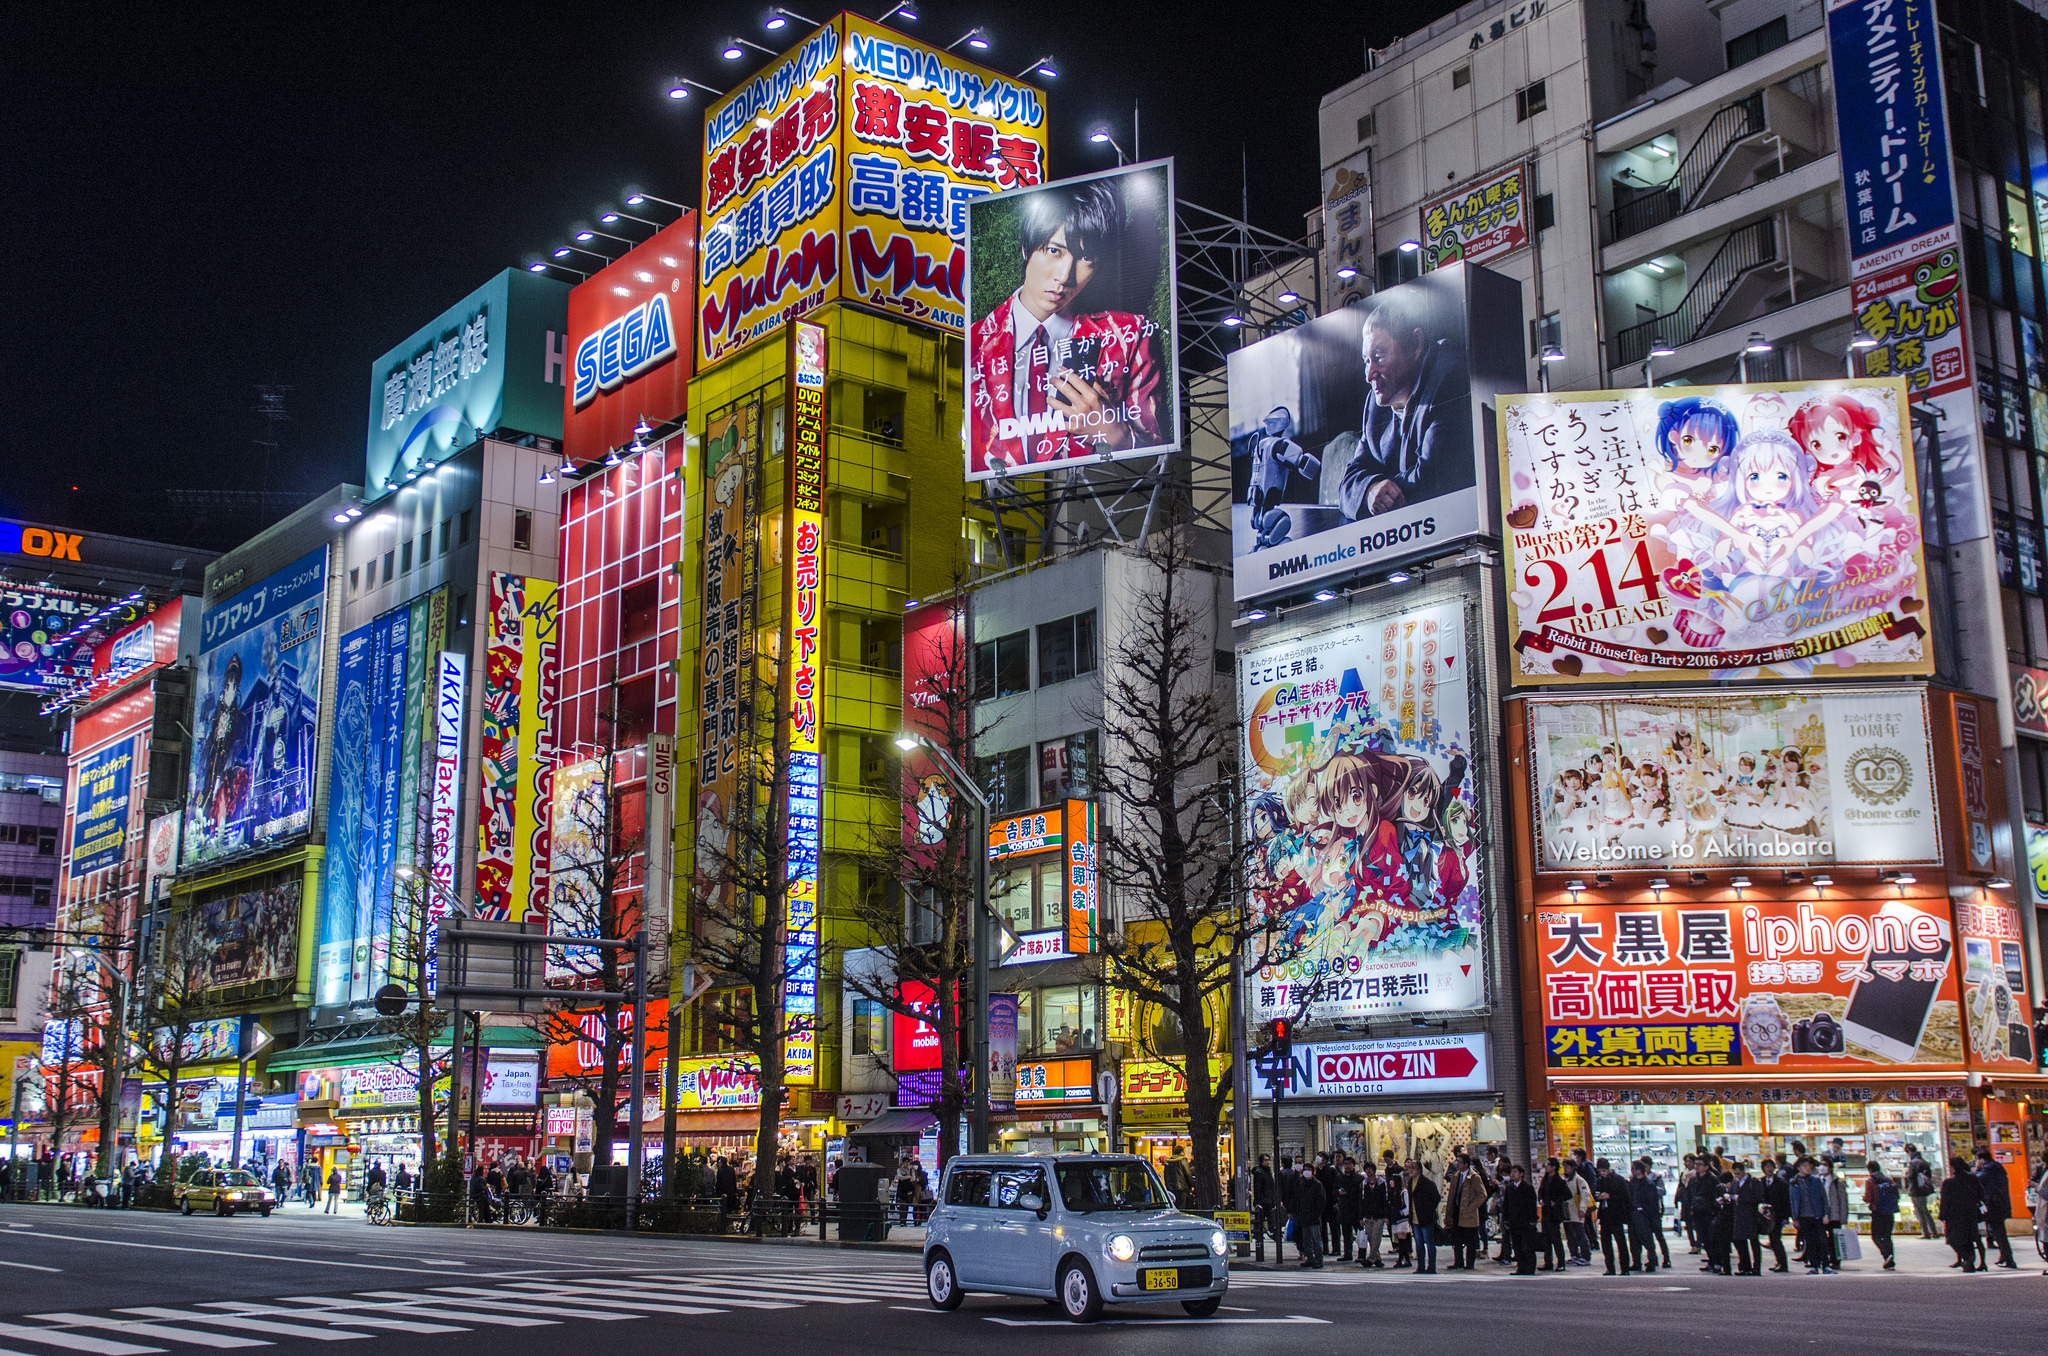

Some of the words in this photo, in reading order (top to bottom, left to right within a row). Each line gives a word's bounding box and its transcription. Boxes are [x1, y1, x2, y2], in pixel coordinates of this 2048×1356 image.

[706, 24, 839, 154] MEDIAリサイクル
[850, 32, 1043, 126] MEDIAリサイクル
[706, 74, 839, 214] 激安販売
[852, 79, 1042, 190] 激安販売
[703, 145, 834, 286] 高額買取
[1427, 175, 1520, 238] まんが喫茶
[1464, 202, 1519, 238] ゲラゲラ
[1855, 168, 1877, 244] 秋葉原店
[1859, 248, 1904, 271] AMENITY
[1911, 231, 1950, 253] DREAM
[702, 229, 839, 359] Mulan
[870, 288, 930, 317] ムーラン
[1858, 297, 1959, 343] まんが
[574, 293, 676, 407] SEGA
[714, 329, 752, 359] ムーラン
[751, 314, 781, 339] AKIBA
[972, 320, 1169, 381] よほど自信があるか、
[1864, 339, 1924, 377] 喫茶
[1936, 361, 1960, 378] 3F
[797, 373, 822, 385] あなたの
[974, 360, 1129, 408] あるいはアホか。
[798, 388, 820, 402] DVD
[797, 402, 822, 418] ブルーレイ
[797, 415, 821, 430] ゲーム
[999, 409, 1066, 440] DMM
[1068, 401, 1142, 429] mobile
[2003, 407, 2026, 441] 5F
[796, 443, 820, 457] アイドル
[801, 429, 816, 442] CD
[1036, 430, 1108, 455] のスマホ
[796, 455, 820, 470] アニメ
[1567, 417, 1602, 494] うさぎ
[1600, 405, 1643, 513] ご注文は
[796, 470, 820, 484] コミック
[797, 484, 819, 496] ホビー
[796, 497, 819, 510] フィギュア
[1359, 517, 1436, 554] ROBOTS
[1515, 529, 1573, 550] Blu-ray
[1572, 514, 1648, 551] 第2巻
[1524, 540, 1669, 625] 2.14
[2019, 555, 2042, 587] 5F
[205, 588, 268, 642] ソフマップ
[1569, 600, 1673, 635] RELEASE
[701, 509, 724, 787] 激安販売の専門店
[1548, 629, 1587, 651] Rabbit
[1651, 647, 1686, 667] Party
[1686, 656, 1718, 668] 2016
[1721, 646, 1797, 666] パシフィコ横浜
[1795, 612, 1893, 658] 5月7日開催!!
[1250, 657, 1325, 686] ここに完結。
[1383, 625, 1398, 711] があった。
[1400, 622, 1416, 741] アートと笑顔
[720, 599, 739, 775] 高額買取と
[1274, 678, 1338, 706] GA芸術科
[1258, 689, 1371, 731] アートデザインクラス
[1849, 723, 1900, 738] 10周年
[655, 742, 670, 795] GAME
[1861, 766, 1887, 781] 10
[1956, 703, 1988, 818] 買取
[435, 754, 457, 858] Tax-free
[789, 785, 802, 795] 5F
[801, 785, 818, 798] 中古
[788, 816, 801, 828] 4F
[791, 803, 816, 815] DVD
[1844, 808, 1891, 820] @home
[1894, 807, 1921, 819] cafe
[1006, 815, 1046, 841] 吉野家
[1975, 825, 1987, 856] 入口
[1008, 838, 1045, 851] YOSHINOYA
[1549, 837, 1664, 863] Welcome
[1671, 840, 1695, 860] to
[1703, 833, 1834, 860] Akihabara
[1071, 841, 1088, 911] 吉野家
[1087, 845, 1096, 910] YOSHINOYA
[789, 900, 814, 914] 買取
[1538, 912, 1567, 923] チケット
[1957, 902, 2021, 940] 買取最強!!
[798, 932, 815, 945] 中古
[1548, 909, 1735, 967] 大黒屋
[1742, 902, 1943, 961] iphone
[1365, 962, 1389, 972] SATOKO
[1390, 960, 1418, 970] KIYUDUKI
[1749, 960, 1823, 985] 携帯
[1836, 960, 1949, 983] スマホ
[786, 981, 800, 993] B1F
[800, 982, 815, 995] 中古
[1546, 970, 1740, 1020] 高価買取
[786, 1031, 813, 1043] ムーラン
[912, 1036, 939, 1048] mobile
[1316, 1043, 1350, 1053] Professional
[1352, 1042, 1375, 1052] Support
[1376, 1041, 1385, 1049] for
[1386, 1039, 1417, 1051] Magazine
[1425, 1036, 1464, 1047] MANGA-ZIN
[1551, 1025, 1736, 1054] 外貨両替
[786, 1048, 813, 1060] AKIBA
[1319, 1054, 1396, 1080] COMIC
[1401, 1052, 1436, 1078] ZIN
[1560, 1054, 1729, 1067] EXCHANGE
[501, 1080, 532, 1088] Tax-free
[505, 1069, 532, 1079] Japan.
[511, 1089, 532, 1099] Shop
[722, 1095, 737, 1104] AKIBA
[1065, 1089, 1092, 1097] YOSHINOYA
[1318, 1083, 1384, 1095] Akihabara
[1558, 1088, 1615, 1103] 高価買取
[1906, 1085, 1966, 1101] 無料査定
[548, 1109, 574, 1119] GAME
[843, 1099, 884, 1117] ラーメン
[547, 1121, 560, 1135] CLUB
[561, 1121, 574, 1135] SEGA
[1153, 1277, 1177, 1288] 36-50
